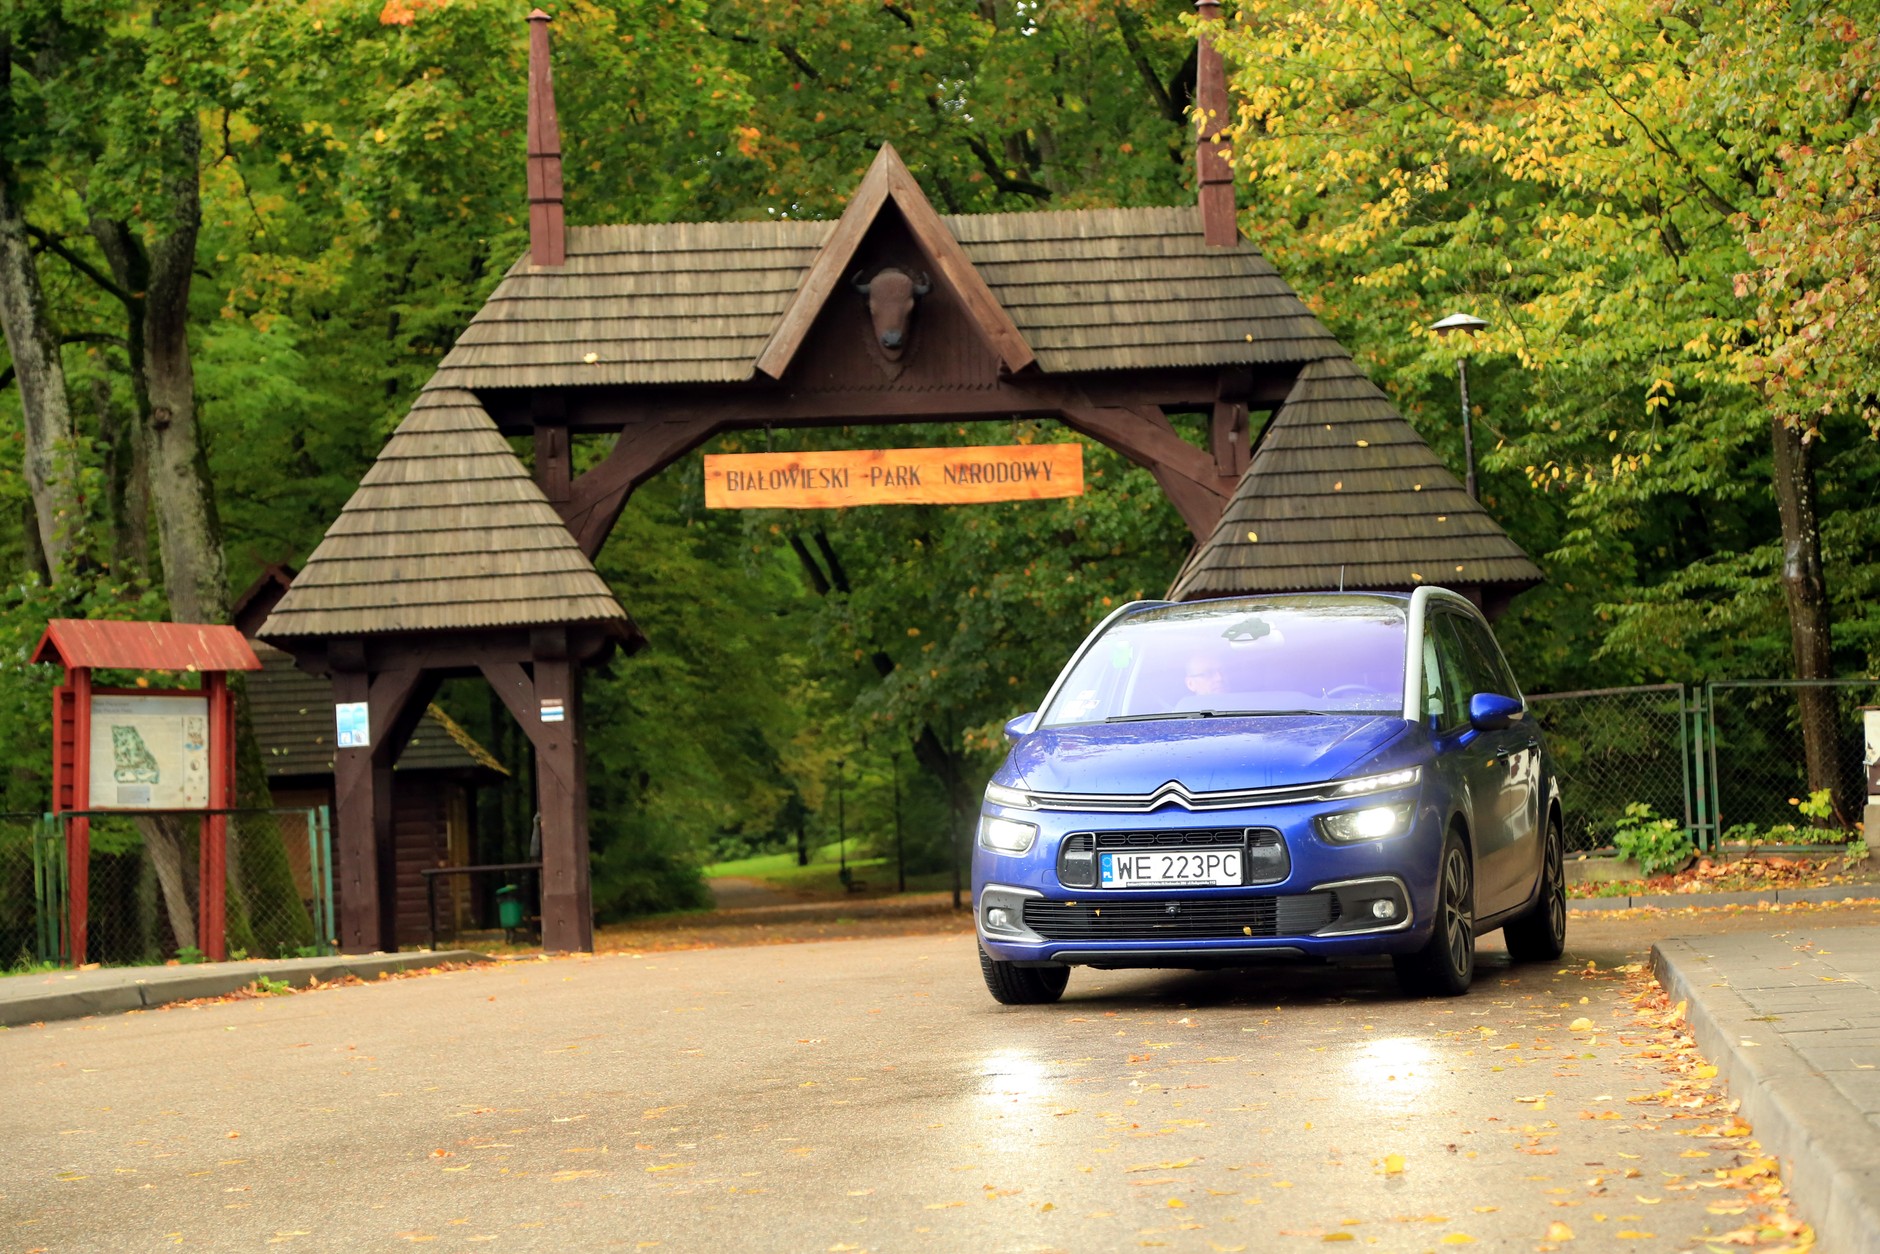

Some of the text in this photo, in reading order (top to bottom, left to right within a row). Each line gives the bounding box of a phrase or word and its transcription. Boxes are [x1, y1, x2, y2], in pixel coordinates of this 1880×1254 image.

[727, 461, 1053, 491] BIAŁOWIESKI PARK NARODOWY
[1103, 871, 1112, 879] PL
[1117, 854, 1237, 879] WE 223PC
